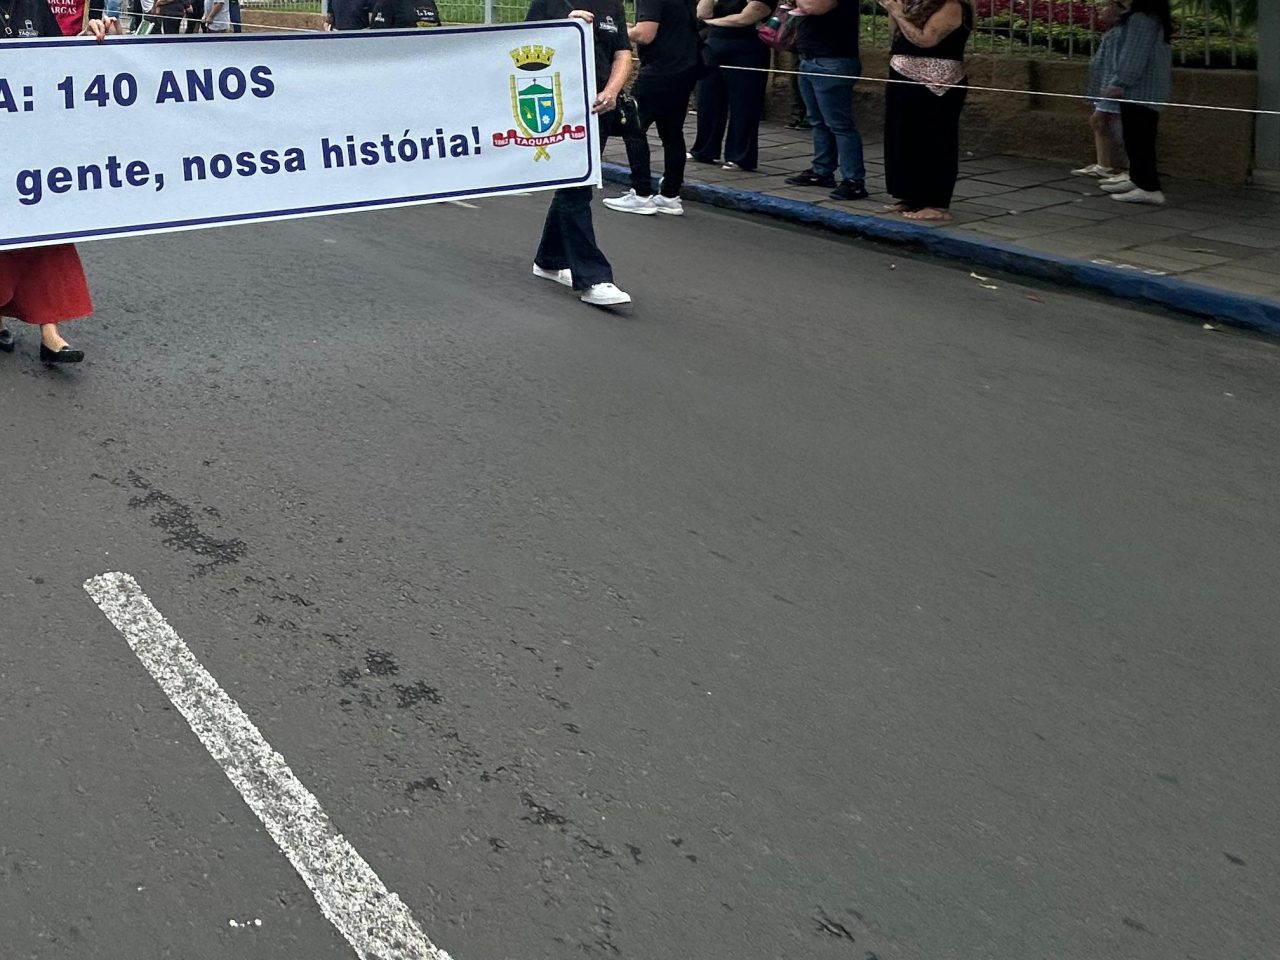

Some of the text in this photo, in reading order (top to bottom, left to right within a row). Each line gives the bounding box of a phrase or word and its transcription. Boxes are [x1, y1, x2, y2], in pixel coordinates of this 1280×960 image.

[50, 6, 77, 15] ARGAS
[57, 72, 138, 109] 140
[156, 65, 275, 104] ANOS
[516, 135, 564, 146] TAQUARA
[16, 154, 166, 206] gente,
[182, 148, 307, 182] nossa
[321, 125, 483, 169] história!
